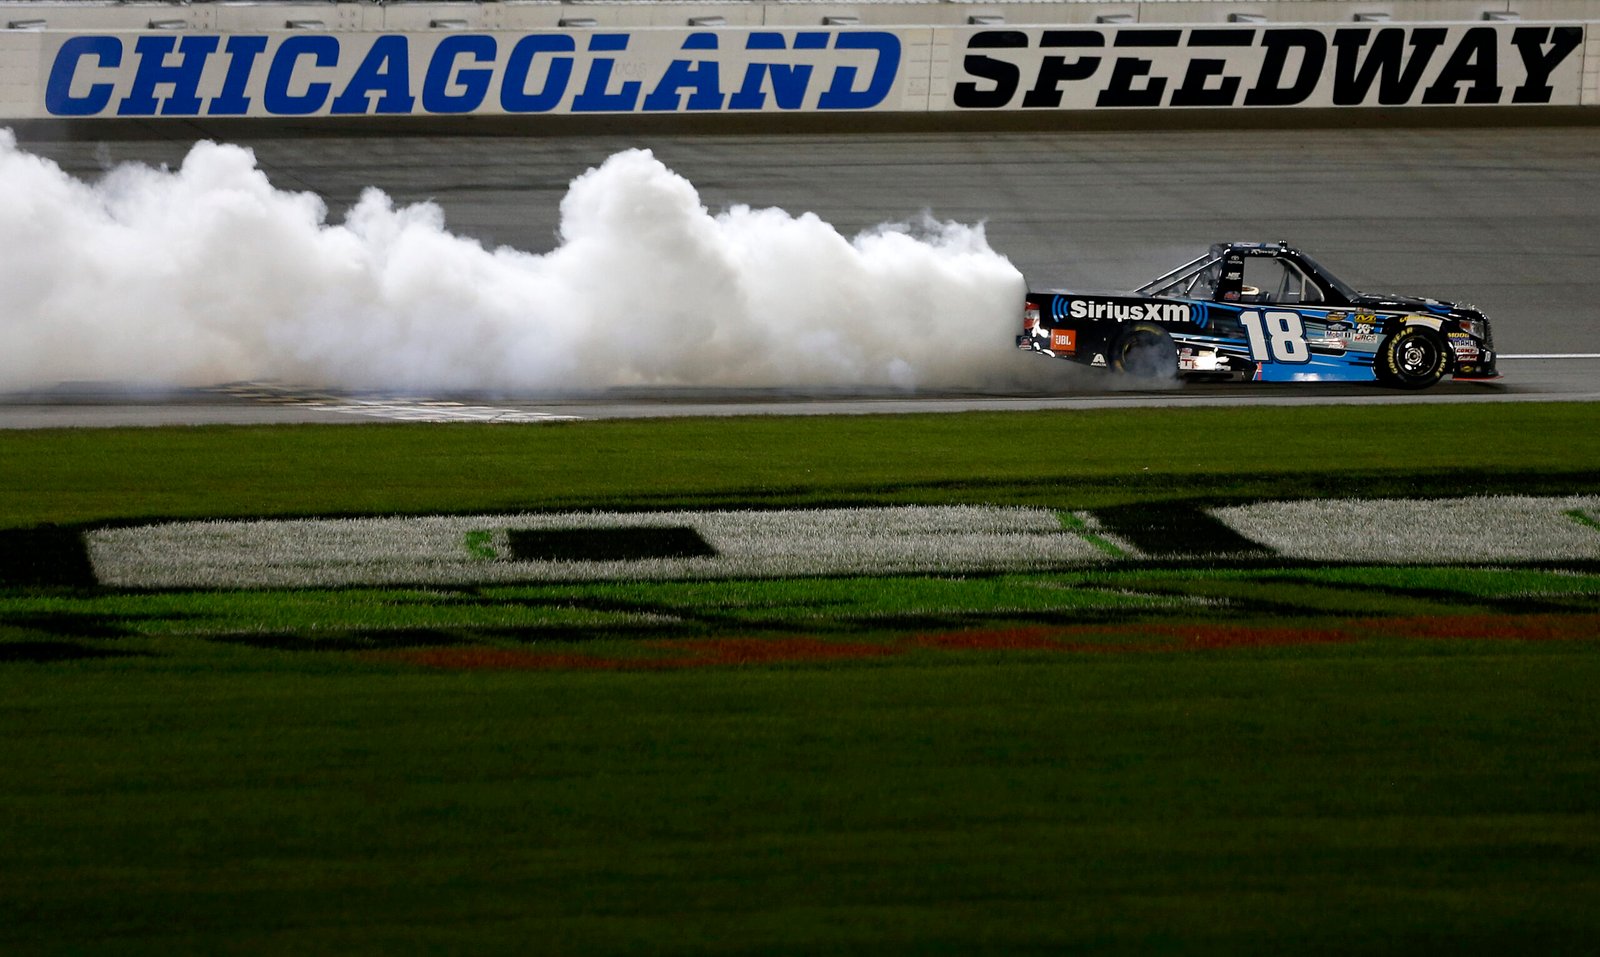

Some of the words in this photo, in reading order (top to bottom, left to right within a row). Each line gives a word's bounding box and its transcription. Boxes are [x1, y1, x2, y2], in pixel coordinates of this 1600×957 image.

[45, 31, 901, 116] CHICAGOLAND
[953, 26, 1584, 109] SPEEDWAY
[1055, 335, 1071, 345] JBL
[1239, 311, 1311, 363] 18
